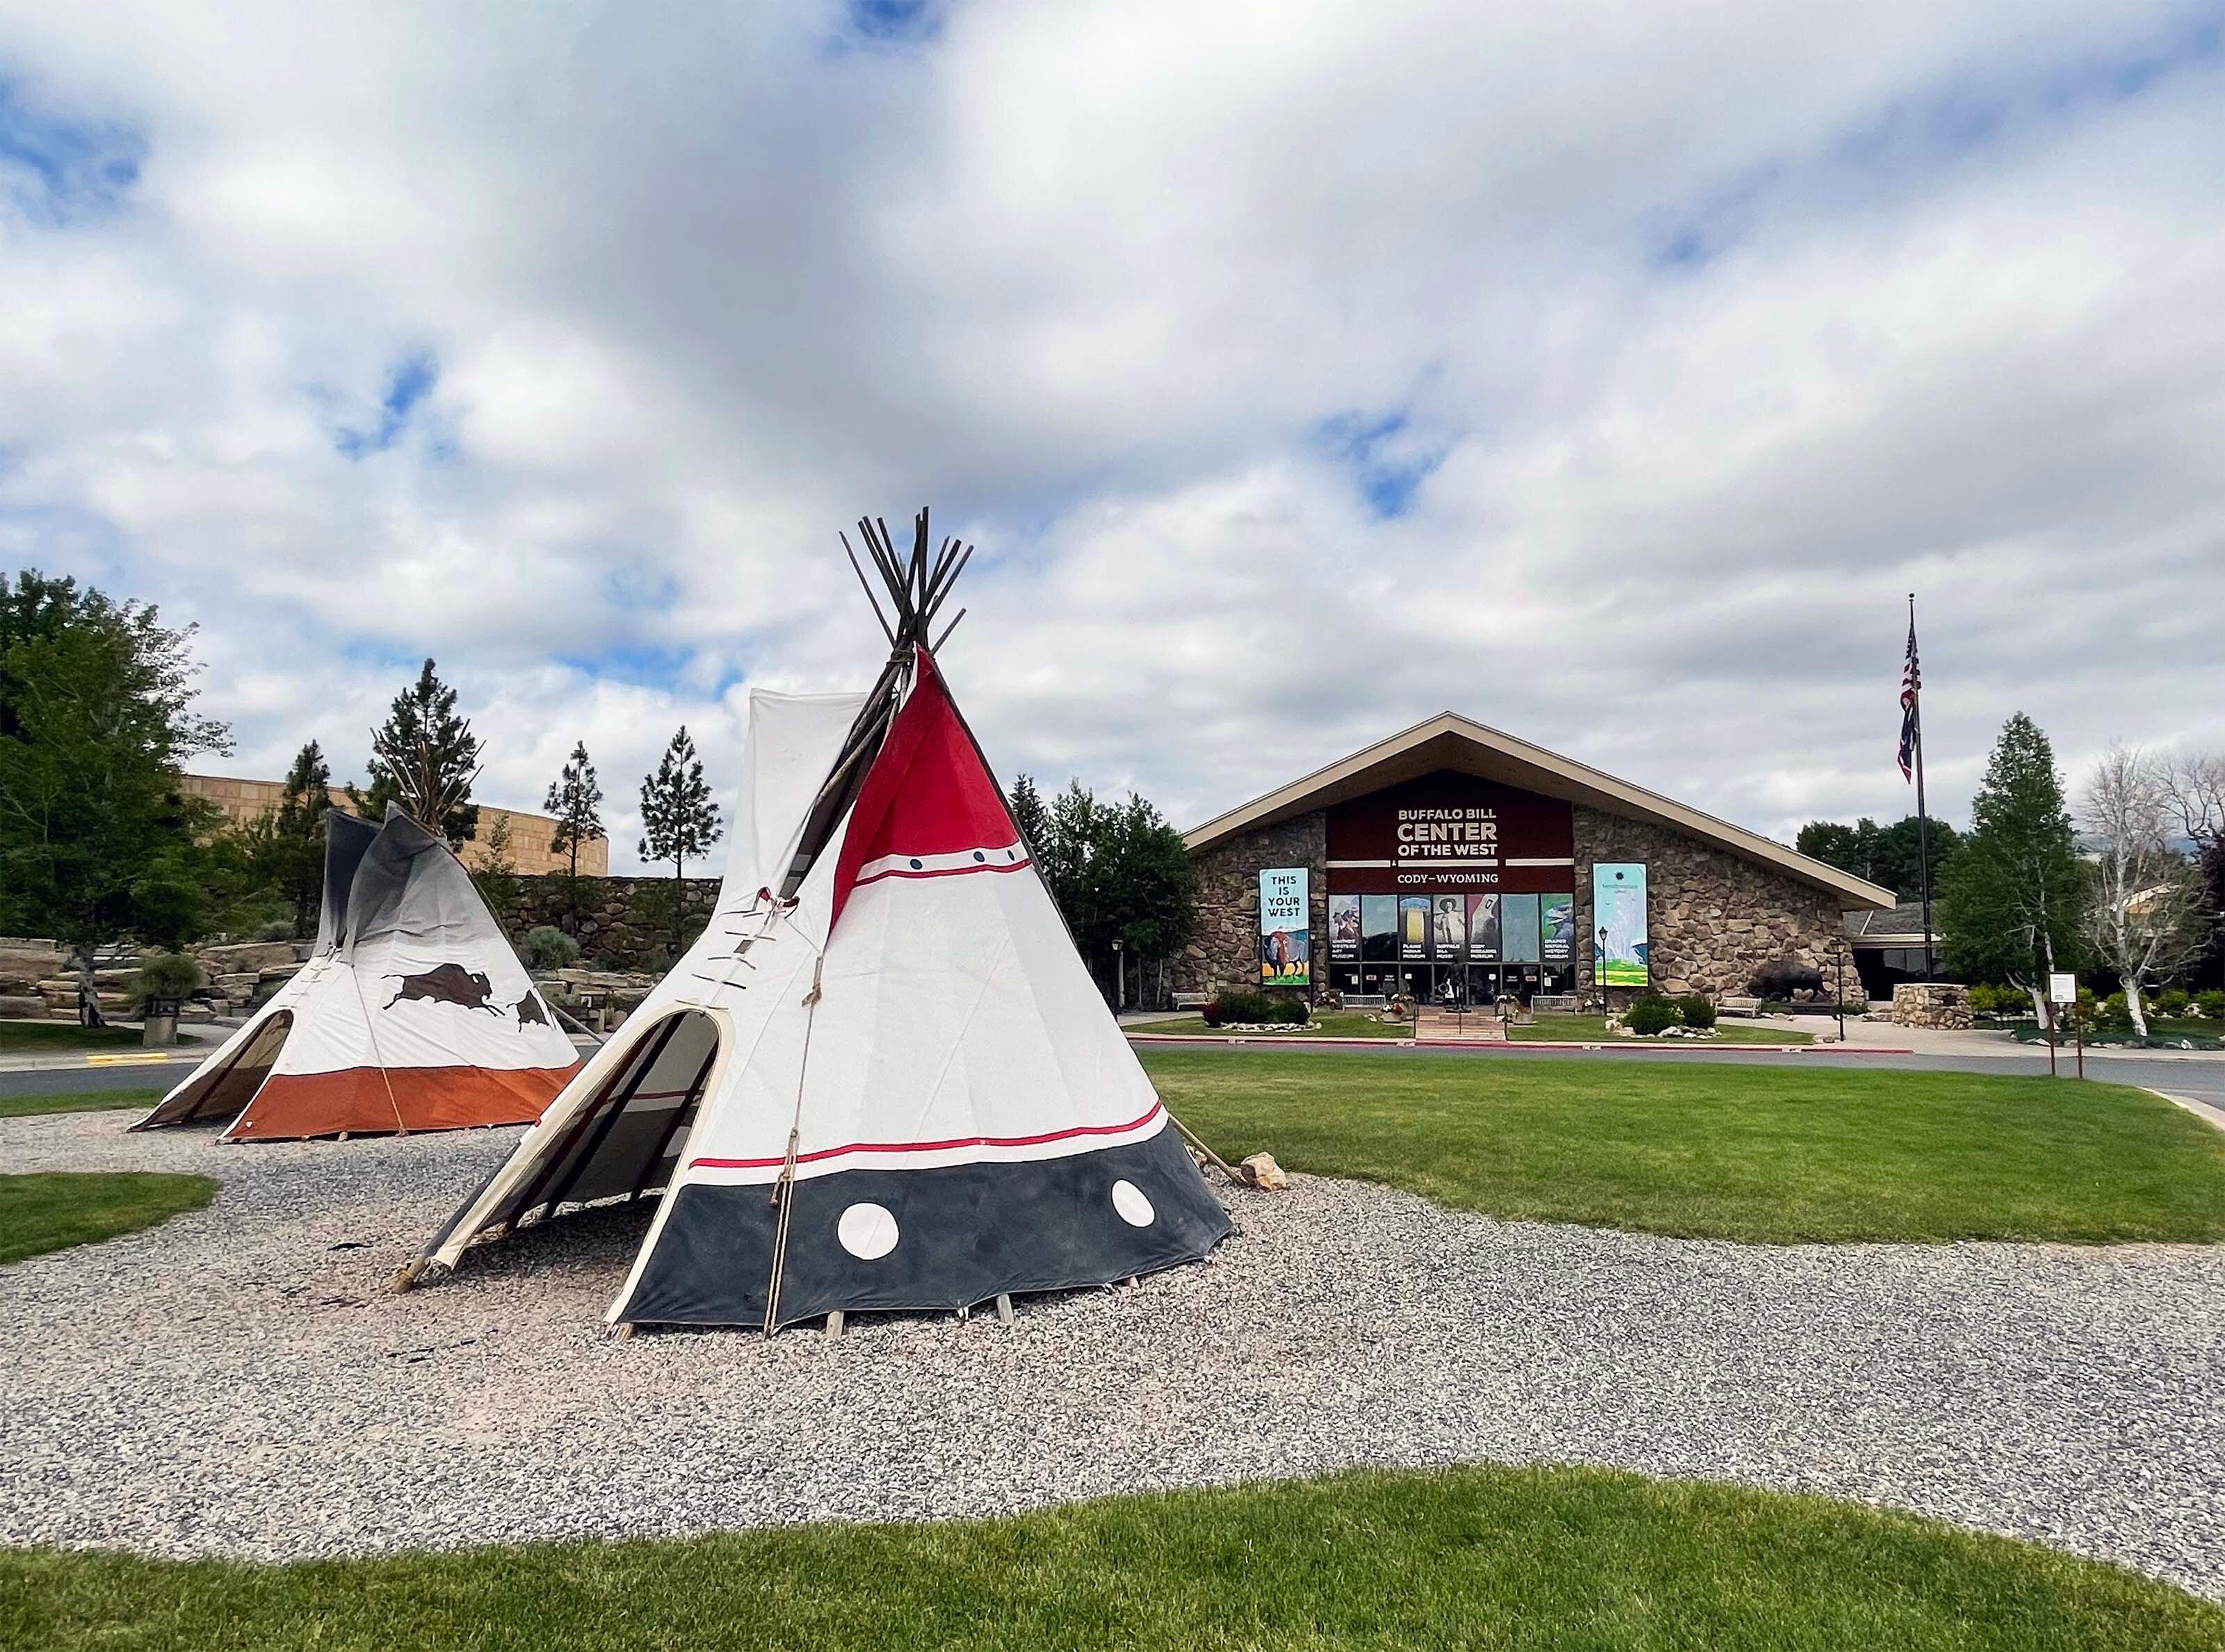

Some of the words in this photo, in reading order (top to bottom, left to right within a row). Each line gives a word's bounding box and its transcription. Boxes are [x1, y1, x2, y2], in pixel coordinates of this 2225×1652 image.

[1398, 809, 1463, 820] BUFFALO
[1466, 808, 1497, 820] BILL
[1397, 823, 1498, 842] CENTER
[1398, 845, 1419, 856] OF
[1421, 844, 1452, 856] THE
[1454, 843, 1498, 856] WEST
[1271, 876, 1297, 885] THIS
[1279, 886, 1290, 896] IS
[1268, 897, 1300, 906] YOUR
[1268, 907, 1300, 917] WEST
